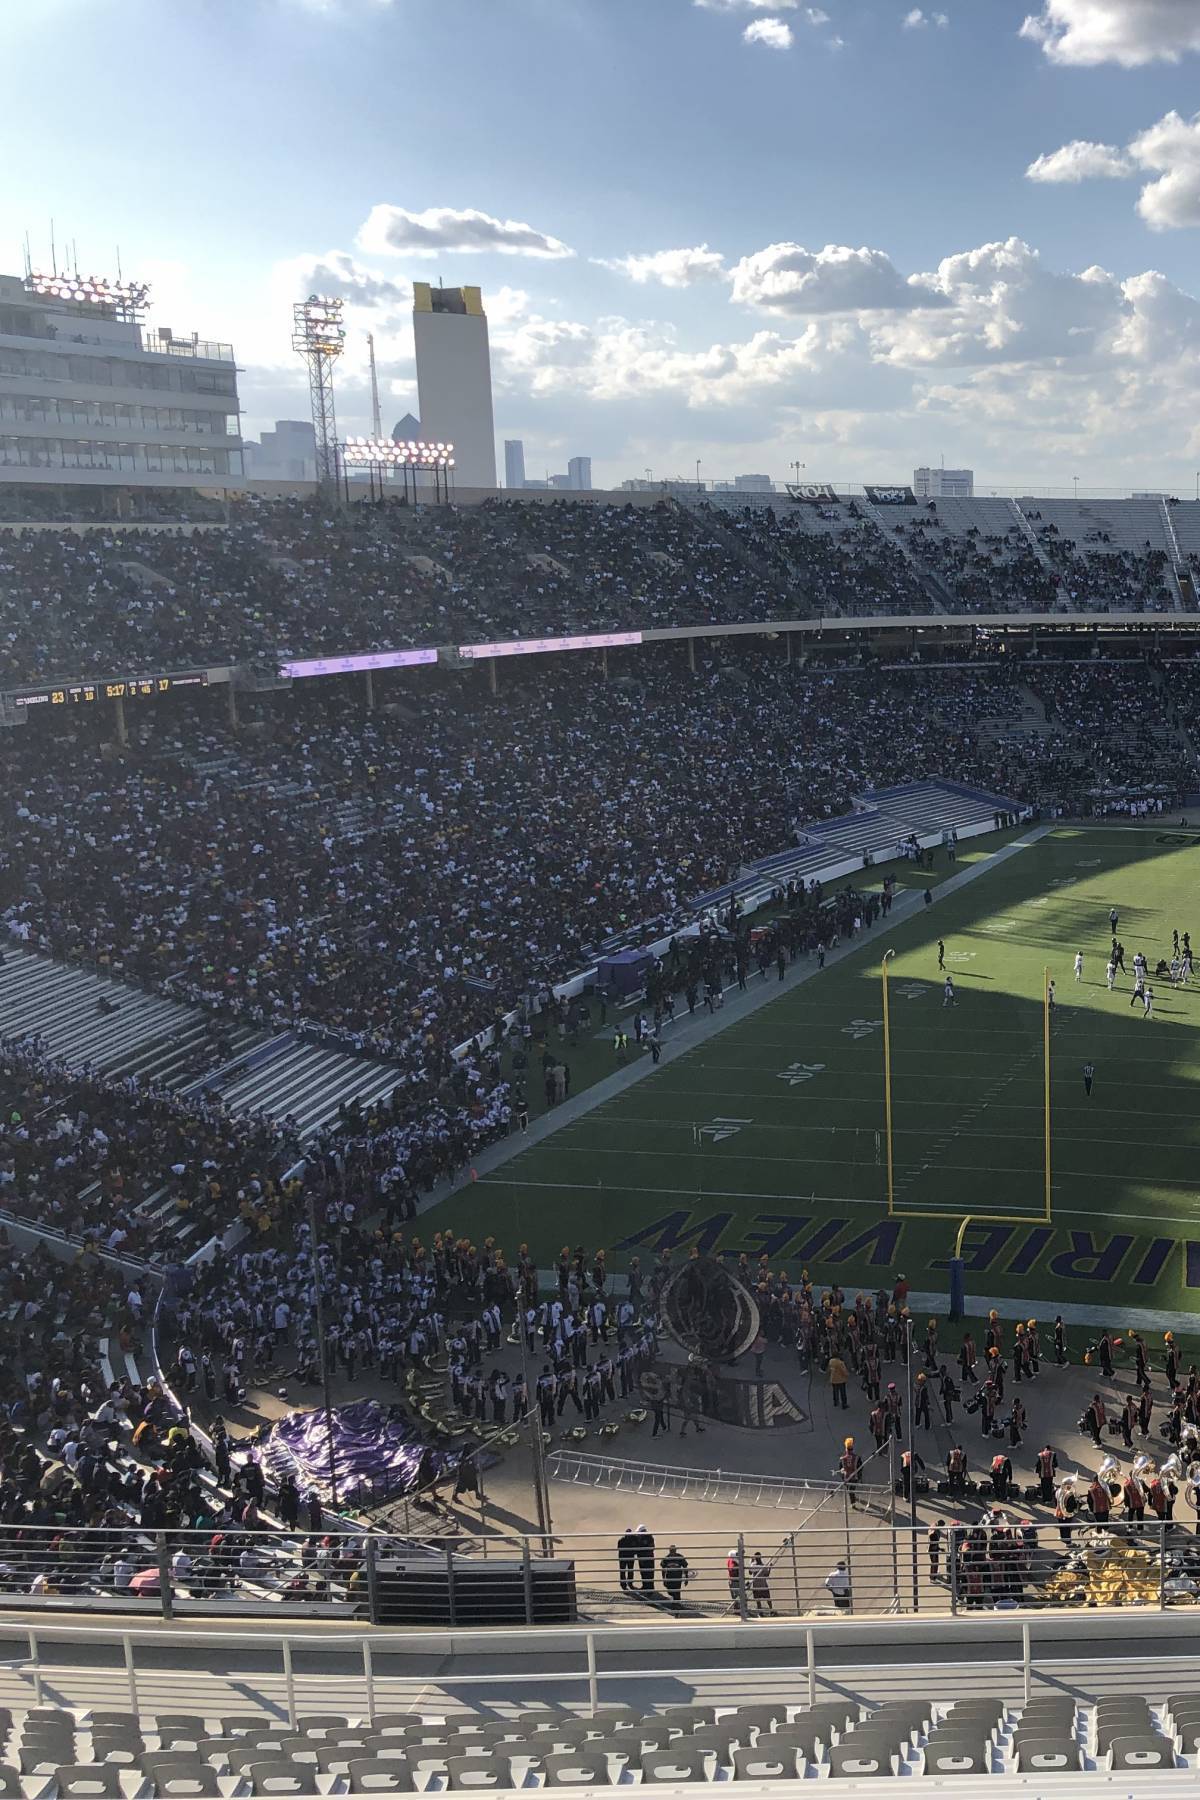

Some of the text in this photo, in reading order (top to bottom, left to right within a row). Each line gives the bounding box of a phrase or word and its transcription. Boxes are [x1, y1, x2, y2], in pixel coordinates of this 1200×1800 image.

[106, 684, 125, 696] 5:17
[159, 679, 168, 691] 17
[52, 692, 64, 704] 23
[608, 1209, 906, 1267] VIEW
